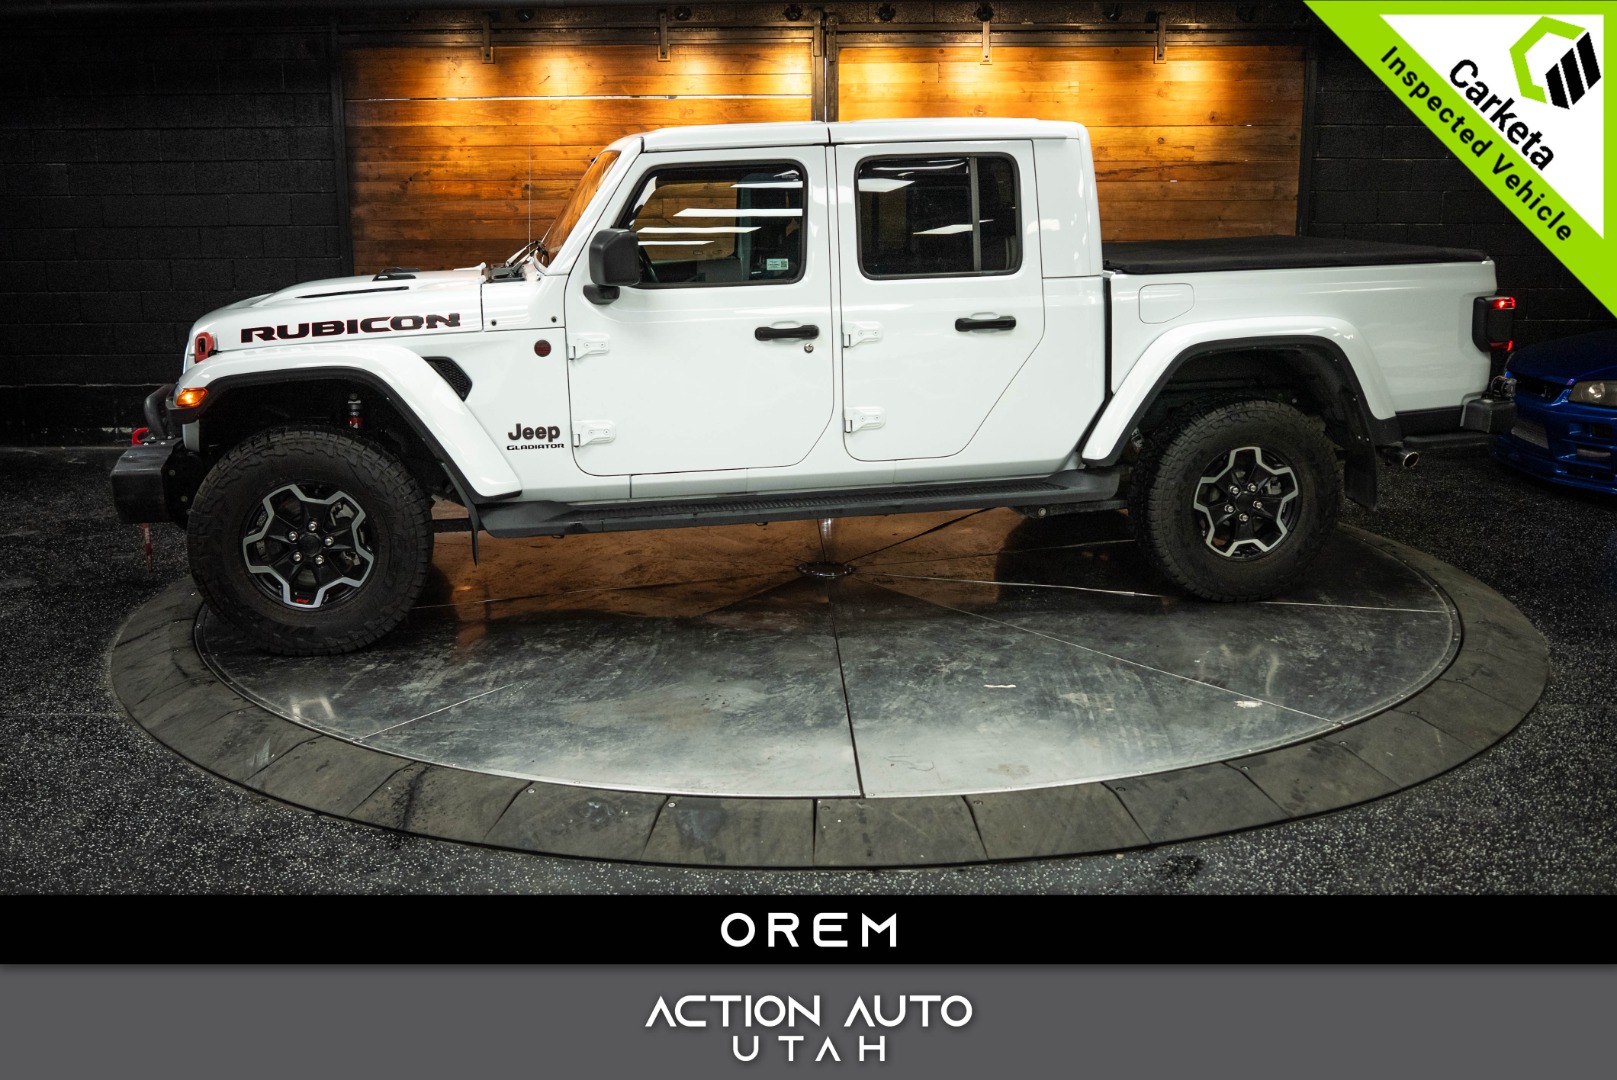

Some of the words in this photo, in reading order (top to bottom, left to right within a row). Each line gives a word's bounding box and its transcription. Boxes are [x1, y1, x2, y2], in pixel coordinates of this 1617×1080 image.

[240, 312, 461, 344] RUBICON
[507, 423, 561, 443] Jeep
[506, 443, 565, 451] GLADIATOR
